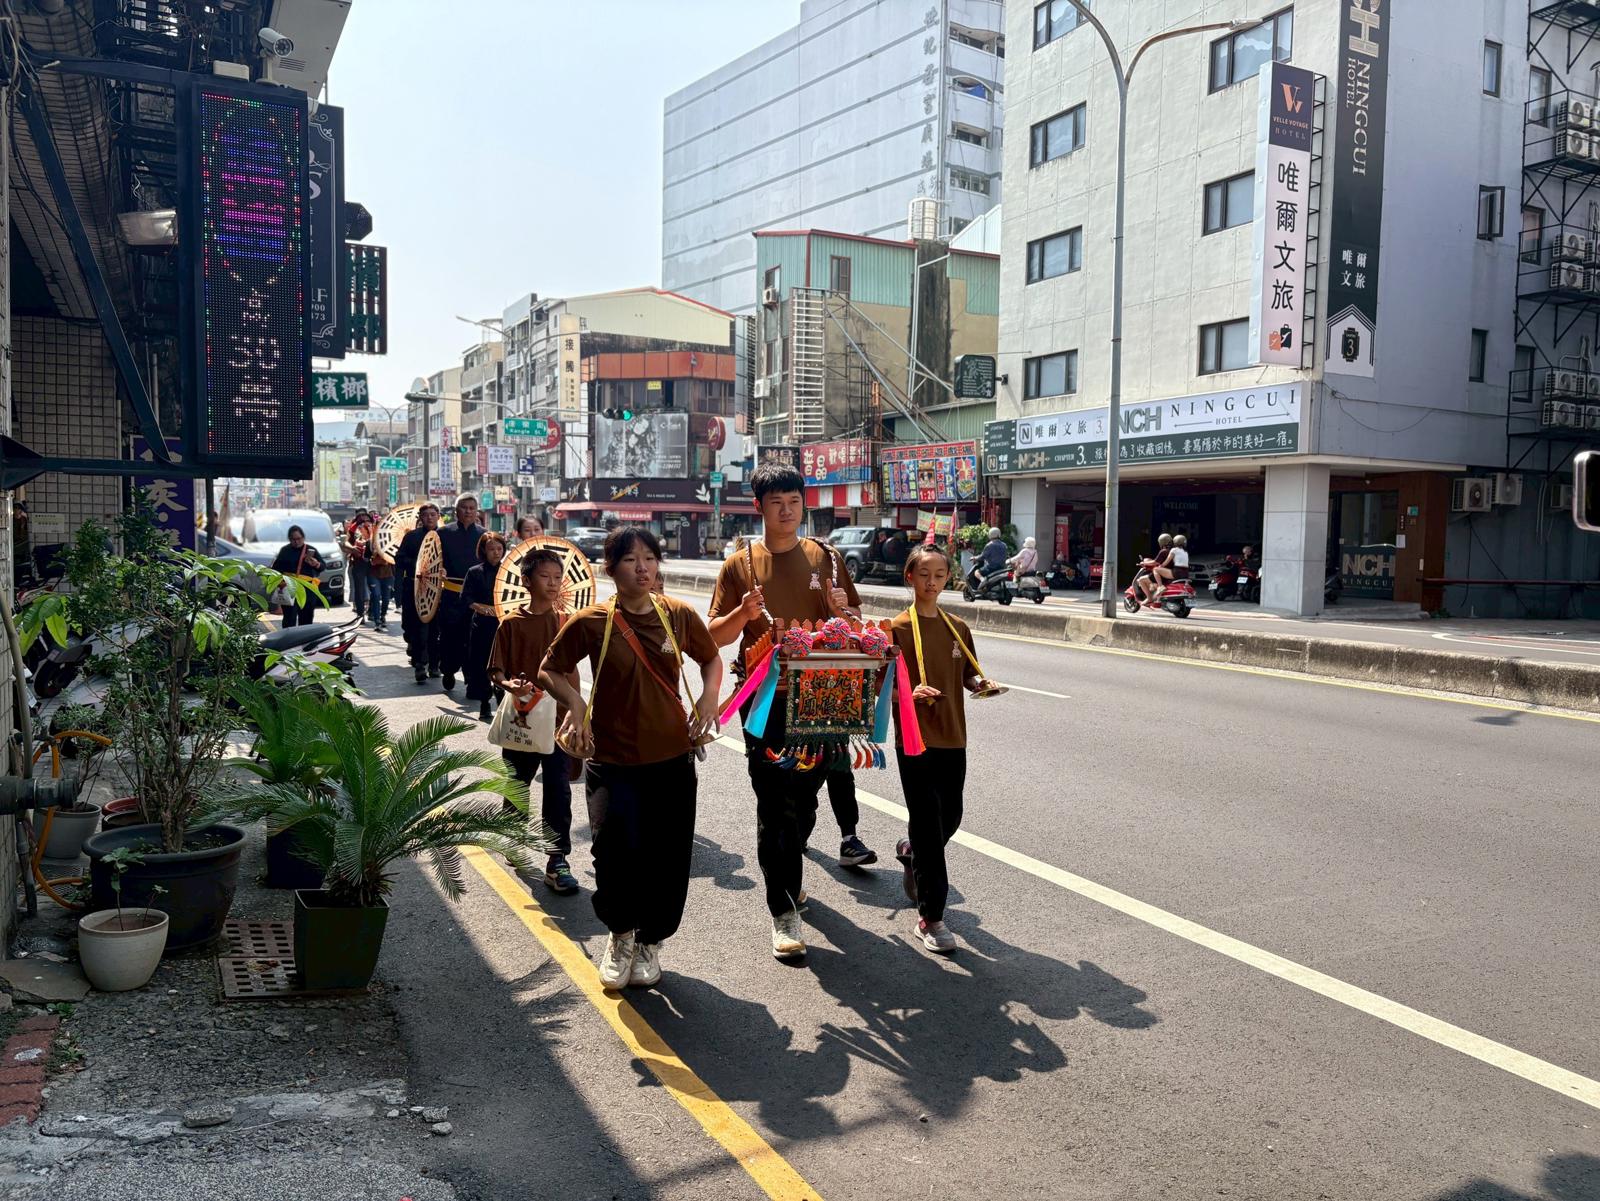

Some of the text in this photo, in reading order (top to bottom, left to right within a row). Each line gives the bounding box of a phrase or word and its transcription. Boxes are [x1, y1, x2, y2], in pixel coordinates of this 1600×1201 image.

[1346, 57, 1357, 109] HOTEL
[1273, 116, 1309, 129] VELLE VOYAGE
[1352, 59, 1371, 177] NINGCUI
[1275, 127, 1306, 140] HOTEL
[1271, 161, 1300, 311] 唯爾文旅
[1346, 339, 1355, 356] 3
[315, 375, 367, 403] 檳榔
[1170, 389, 1296, 418] NINGCUI
[1034, 420, 1088, 439] 唯爾文旅
[1216, 415, 1242, 425] HOTEL
[1018, 451, 1046, 470] NCH
[1342, 554, 1396, 576] NCH
